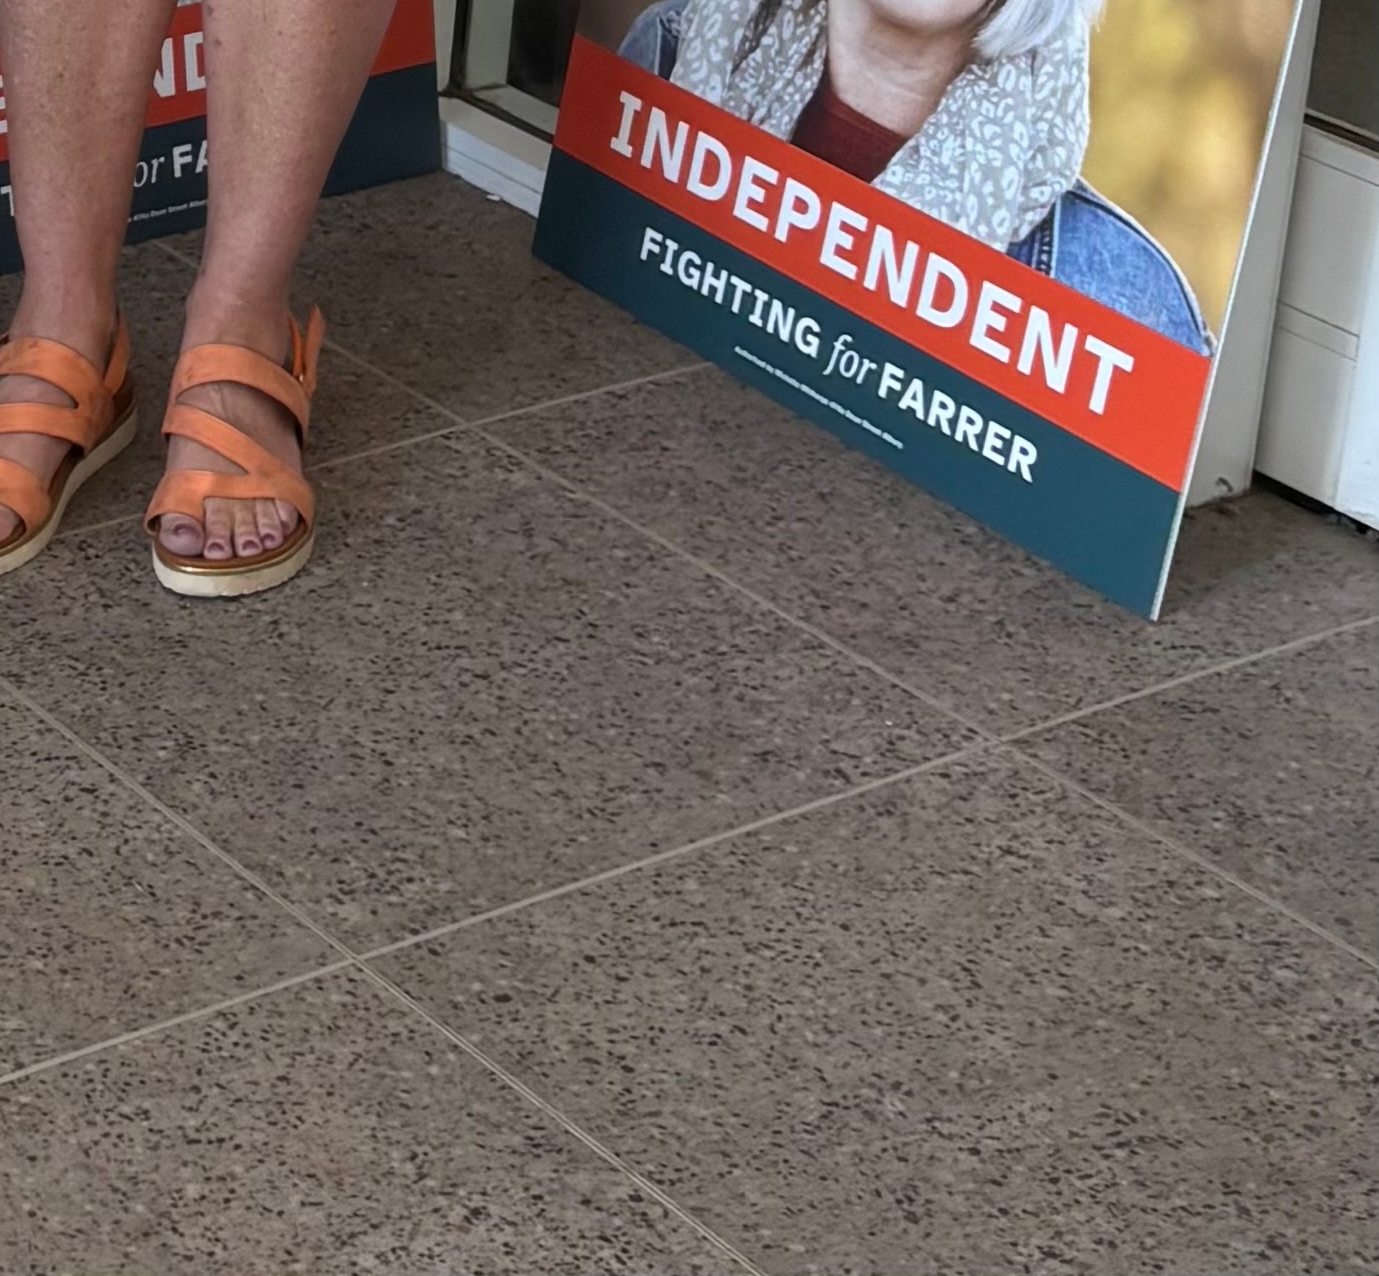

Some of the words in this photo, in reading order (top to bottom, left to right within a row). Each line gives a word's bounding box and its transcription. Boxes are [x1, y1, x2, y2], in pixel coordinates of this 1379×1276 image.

[609, 90, 1134, 415] INDEPENDENT
[640, 226, 820, 359] FIGHTING
[822, 333, 879, 386] for
[877, 361, 1039, 484] FARRER
